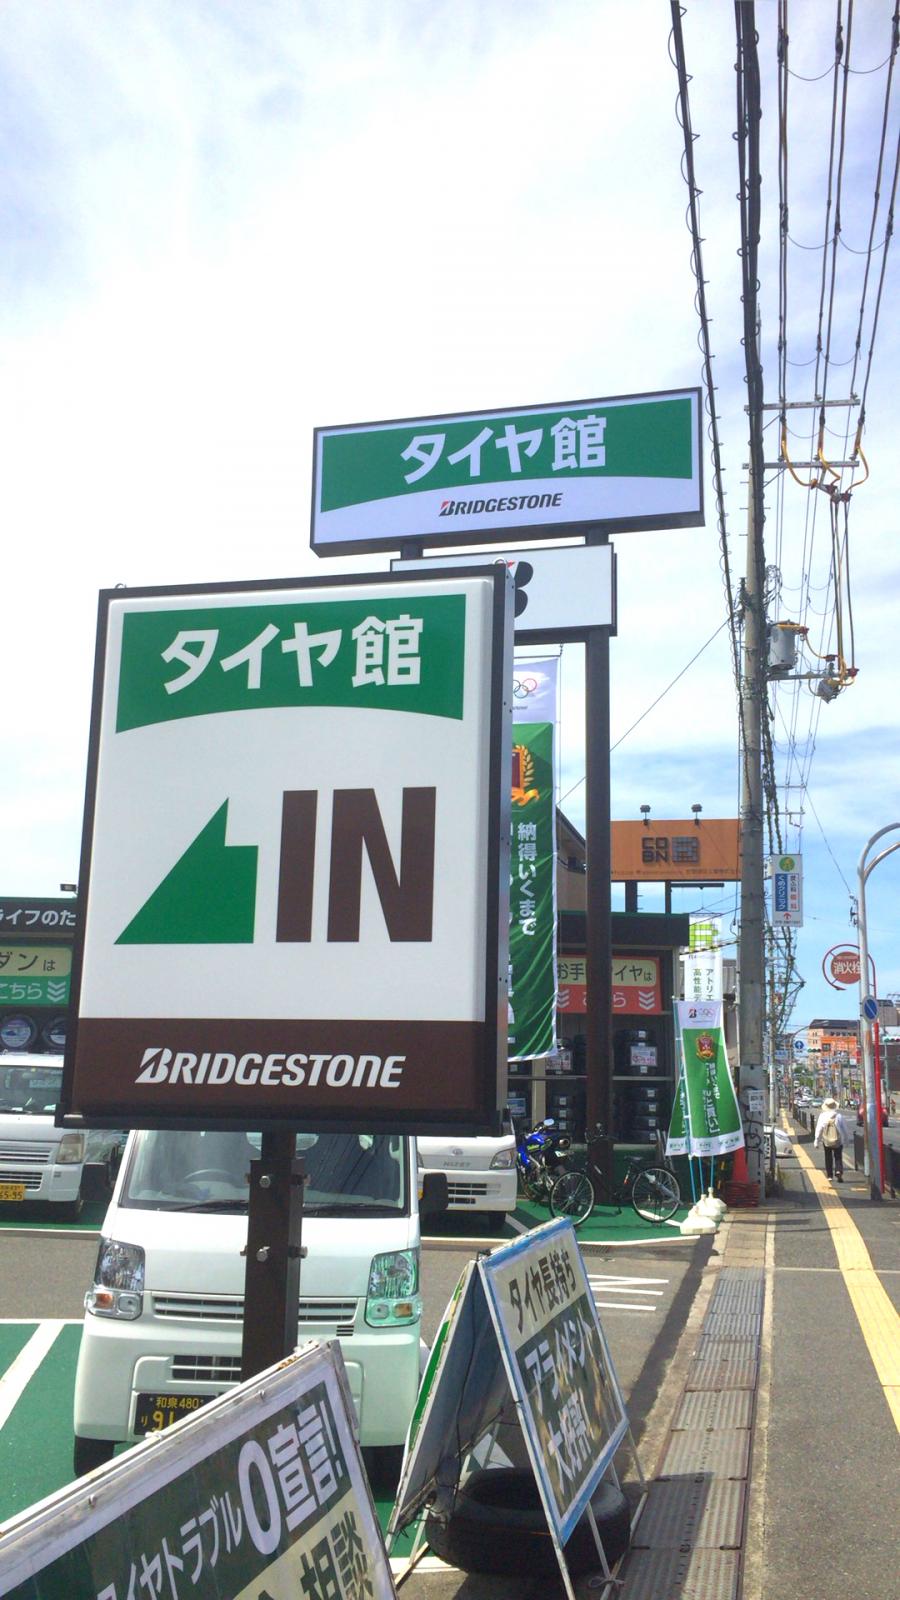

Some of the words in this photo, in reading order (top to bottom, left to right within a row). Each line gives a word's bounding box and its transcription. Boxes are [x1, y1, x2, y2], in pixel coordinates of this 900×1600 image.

[401, 415, 607, 485] タイヤ館
[439, 493, 563, 517] BRIDGESTONE
[161, 614, 424, 695] タイヤ館
[276, 786, 437, 942] IN
[517, 822, 537, 936] 納得いくまで
[0, 909, 77, 926] イフのた
[135, 1048, 406, 1088] BRIDGESTONE
[508, 1248, 576, 1336] タイヤ長持ち
[524, 1307, 593, 1416] アライメント
